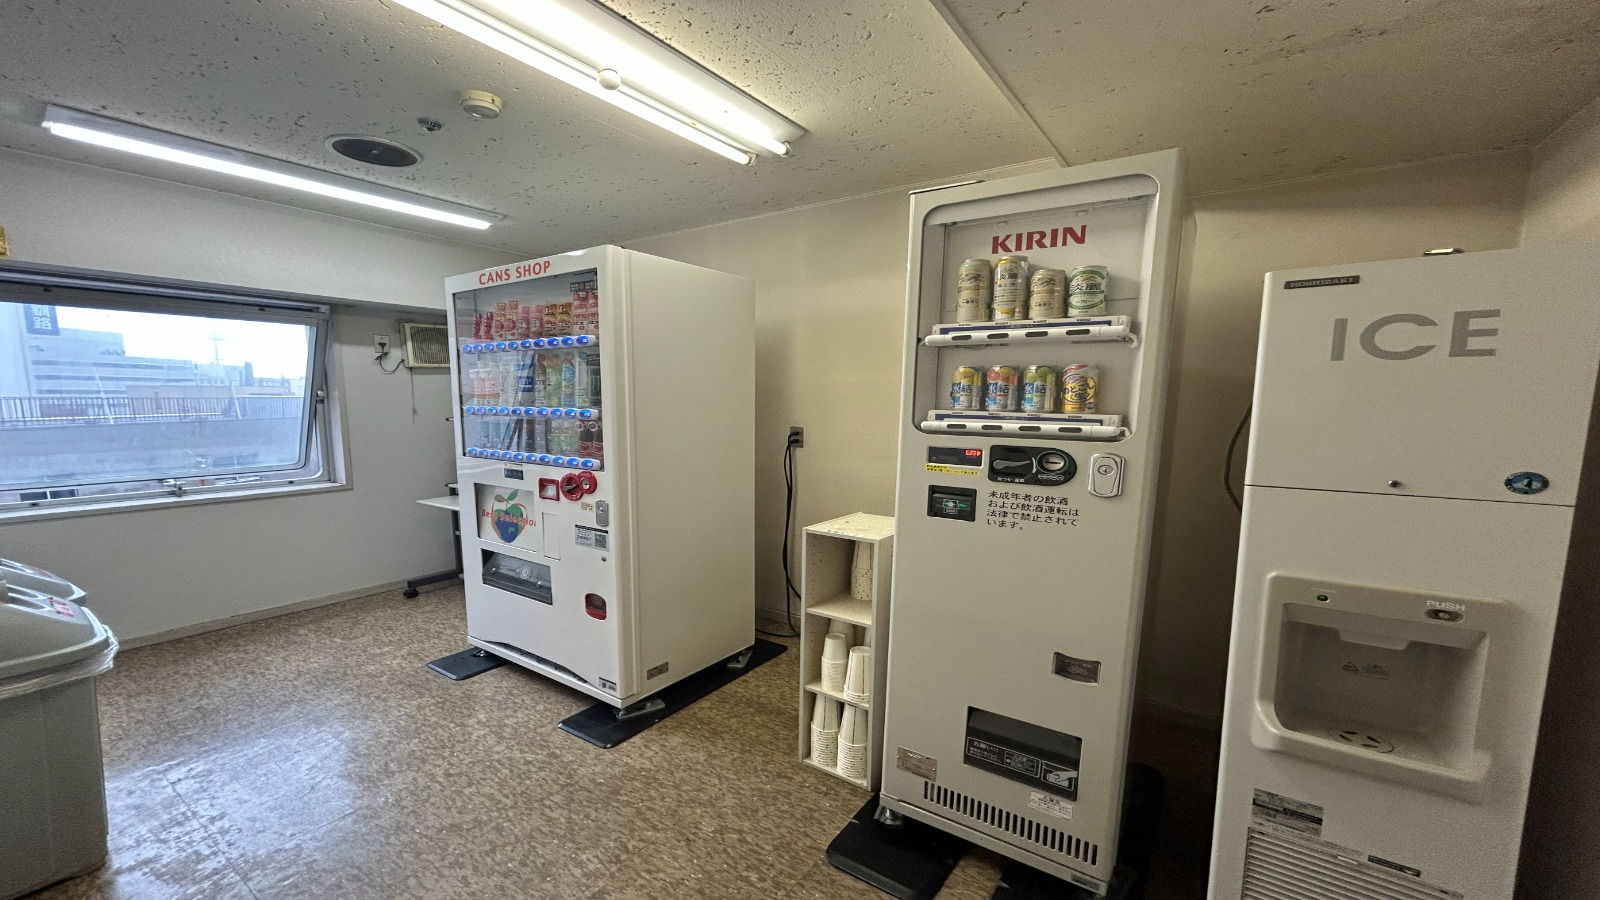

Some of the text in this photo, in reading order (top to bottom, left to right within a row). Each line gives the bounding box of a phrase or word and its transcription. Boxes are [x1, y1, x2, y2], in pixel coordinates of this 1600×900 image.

[991, 225, 1087, 254] KIRIN
[478, 260, 551, 286] CANS SHOP
[1290, 277, 1354, 288] HOSHIZAKI
[1330, 309, 1501, 361] ICE
[988, 490, 1069, 506] 未成年者の飲酒
[987, 499, 1080, 517] および飲酒運転は
[986, 508, 1079, 527] 法律で禁止されて
[986, 518, 1024, 531] います。
[1426, 600, 1466, 611] PUSH
